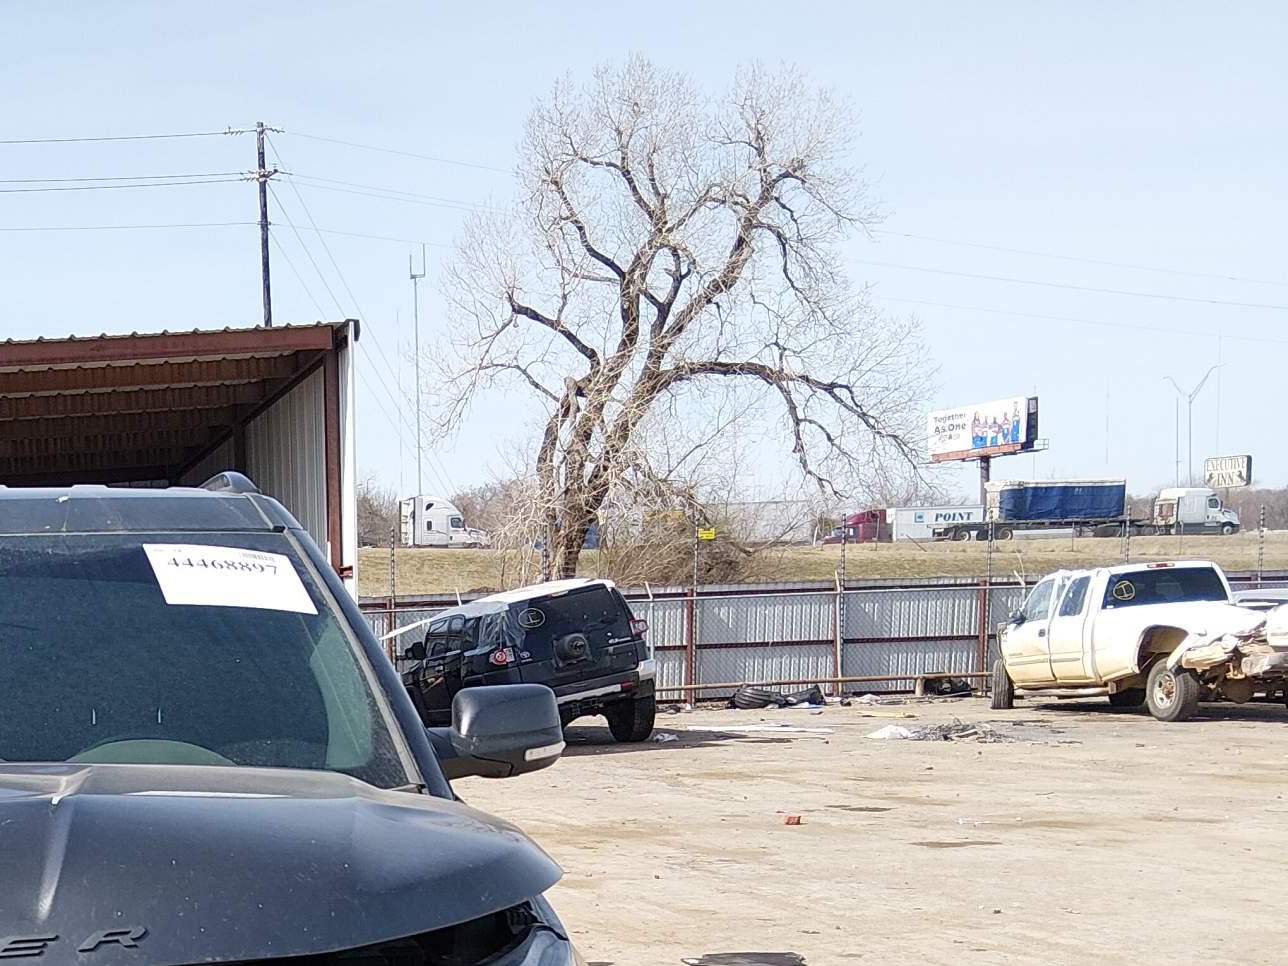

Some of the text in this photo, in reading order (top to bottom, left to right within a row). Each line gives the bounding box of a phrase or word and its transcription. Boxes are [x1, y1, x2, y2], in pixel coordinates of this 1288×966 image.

[947, 422, 967, 432] One
[1207, 457, 1245, 472] EXECUTIVE
[1217, 471, 1234, 486] INN
[935, 511, 973, 522] POINT
[168, 556, 278, 576] 44468897
